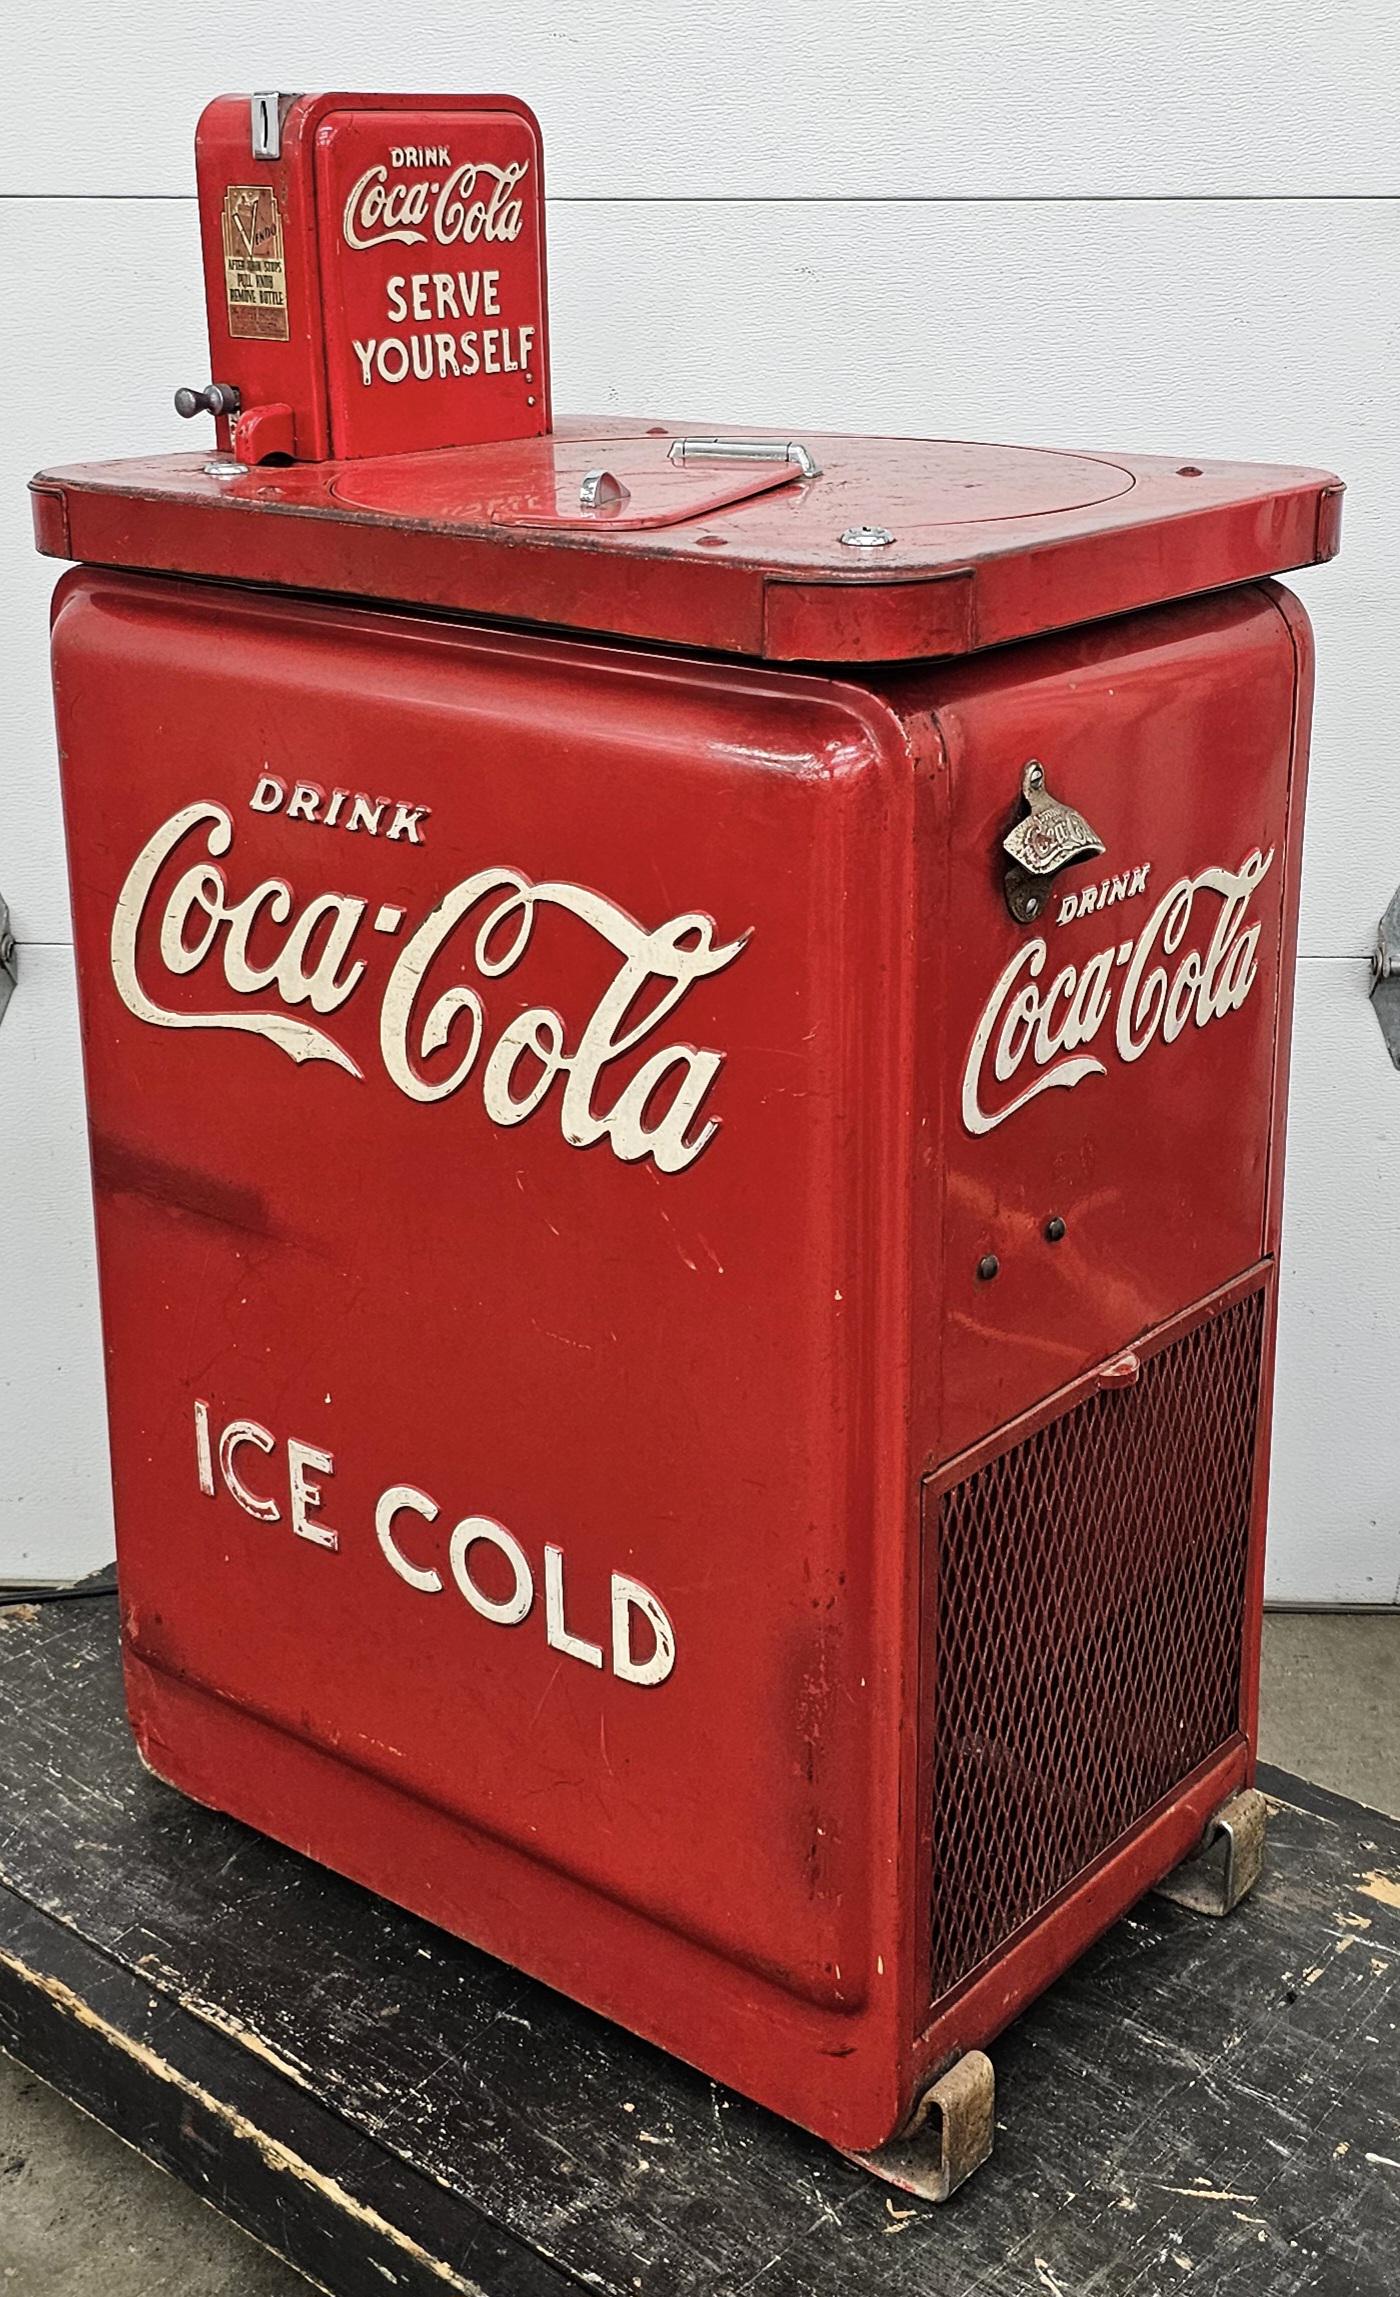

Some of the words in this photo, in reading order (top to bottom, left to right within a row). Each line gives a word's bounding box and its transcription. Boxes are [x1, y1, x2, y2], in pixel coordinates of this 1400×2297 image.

[391, 146, 451, 168] DRINK
[343, 159, 529, 250] Coca-Cola
[387, 270, 501, 323] SERVE
[352, 327, 535, 386] YOURSELF
[249, 776, 424, 843] DRINK
[1056, 862, 1151, 927] DRINK
[111, 799, 755, 1173] Coca-Cola
[962, 845, 1276, 1135] Coca-Cola
[194, 1399, 339, 1551] ICE
[375, 1484, 676, 1686] COLD
